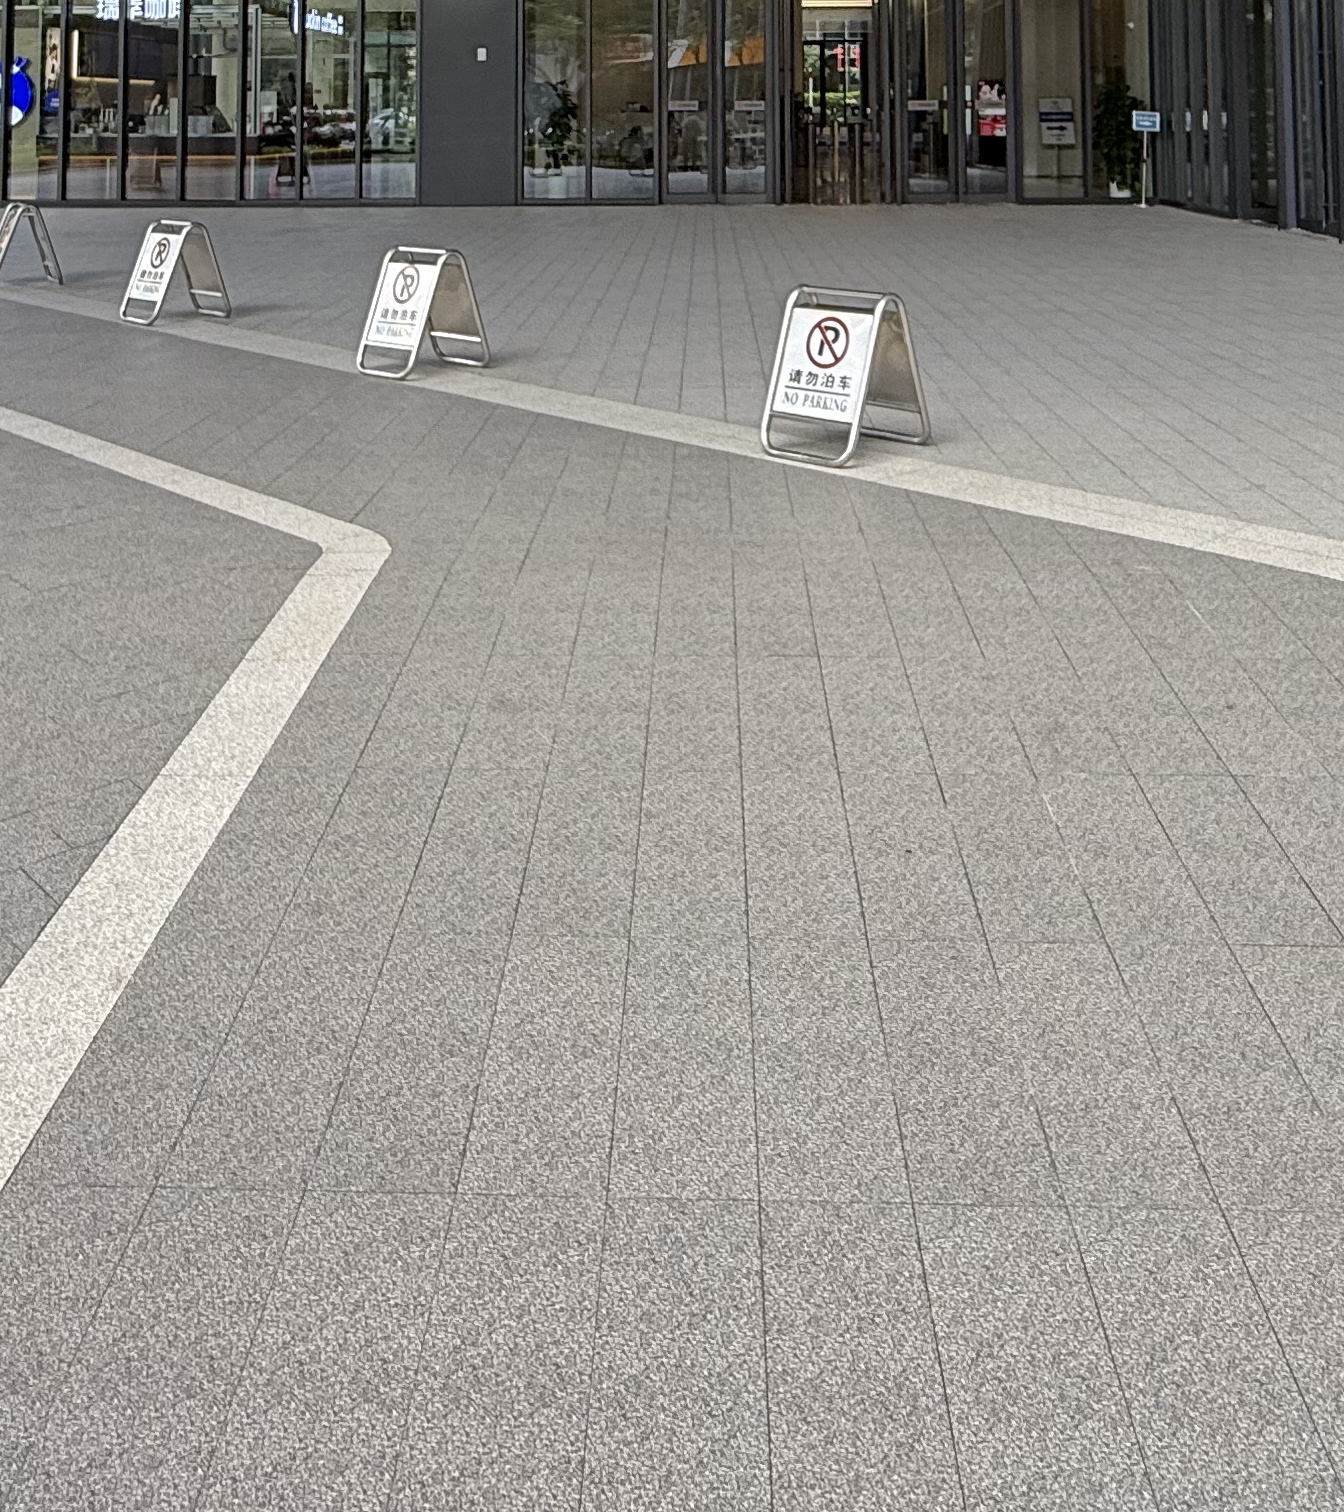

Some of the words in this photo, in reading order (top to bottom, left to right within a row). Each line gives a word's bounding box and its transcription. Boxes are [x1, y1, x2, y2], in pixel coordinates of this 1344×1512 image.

[788, 368, 853, 391] 请勿泊车
[781, 391, 799, 406] NO
[802, 393, 848, 413] PARKING
